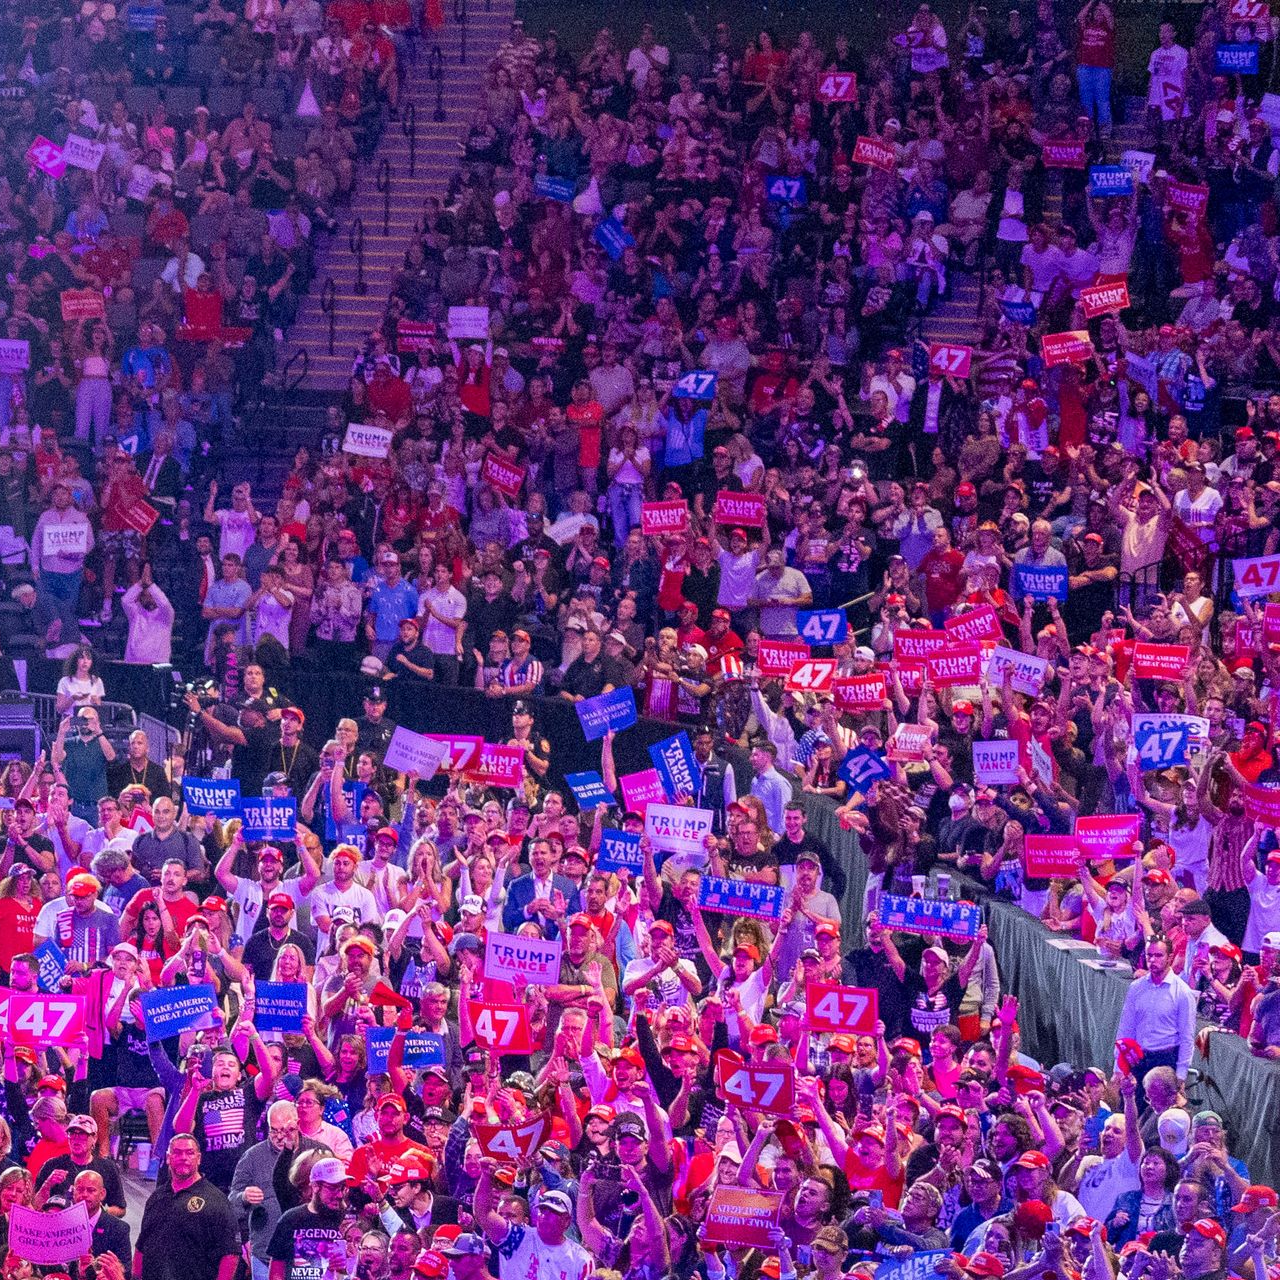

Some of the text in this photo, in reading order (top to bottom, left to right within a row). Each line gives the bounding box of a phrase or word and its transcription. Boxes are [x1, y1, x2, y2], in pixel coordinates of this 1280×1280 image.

[1217, 50, 1255, 60] TRUMP
[820, 77, 851, 97] 47
[33, 144, 62, 170] 47
[1092, 171, 1131, 181] TRUMP
[769, 180, 801, 198] 47
[933, 347, 966, 371] 47
[677, 373, 715, 394] 47
[719, 499, 761, 511] TRUMP
[644, 508, 685, 520] TRUMP
[45, 529, 87, 543] TRUMP
[1019, 573, 1064, 583] TRUMP
[1242, 561, 1280, 587] 47
[1022, 581, 1060, 591] VANCE
[803, 614, 840, 640] 47
[950, 614, 993, 635] TRUMP
[957, 625, 991, 642] VANCE
[896, 637, 943, 648] TRUMP
[762, 648, 807, 659] TRUMP
[1154, 654, 1186, 663] AMERICA
[929, 655, 978, 669] TRUMP
[791, 663, 832, 687] 47
[935, 665, 972, 676] VANCE
[837, 683, 883, 696] TRUMP
[842, 691, 880, 701] VANCE
[1141, 731, 1183, 764] 47
[976, 752, 1016, 763] TRUMP
[671, 739, 695, 797] TRUMP
[846, 753, 884, 783] 47
[979, 761, 1011, 770] VANCE
[186, 787, 236, 799] TRUMP
[192, 796, 232, 807] VANCE
[245, 808, 293, 818] TRUMP
[248, 817, 288, 827] VANCE
[650, 815, 707, 830] TRUMP
[655, 827, 699, 839] VANCE
[1078, 828, 1135, 838] MAKE AMERICA
[1082, 836, 1105, 845] GREAT
[709, 878, 776, 900] TRUMP
[891, 899, 970, 919] TRUMP
[492, 943, 555, 964] TRUMP
[498, 956, 548, 973] VANCE
[147, 996, 213, 1017] MAKE AMERICA
[271, 999, 303, 1009] AMERICA
[814, 992, 868, 1026] 47
[15, 1002, 77, 1036] 47
[153, 1005, 210, 1024] GREAT AGAIN
[278, 1007, 299, 1017] AGAIN
[475, 1010, 519, 1046] 47
[724, 1069, 785, 1106] 47
[206, 1131, 245, 1146] TRUMP
[488, 1118, 545, 1158] 47
[14, 1224, 87, 1239] MAKE AMERICA
[293, 1229, 343, 1240] LEGENDS
[18, 1235, 83, 1248] GREAT AGAIN
